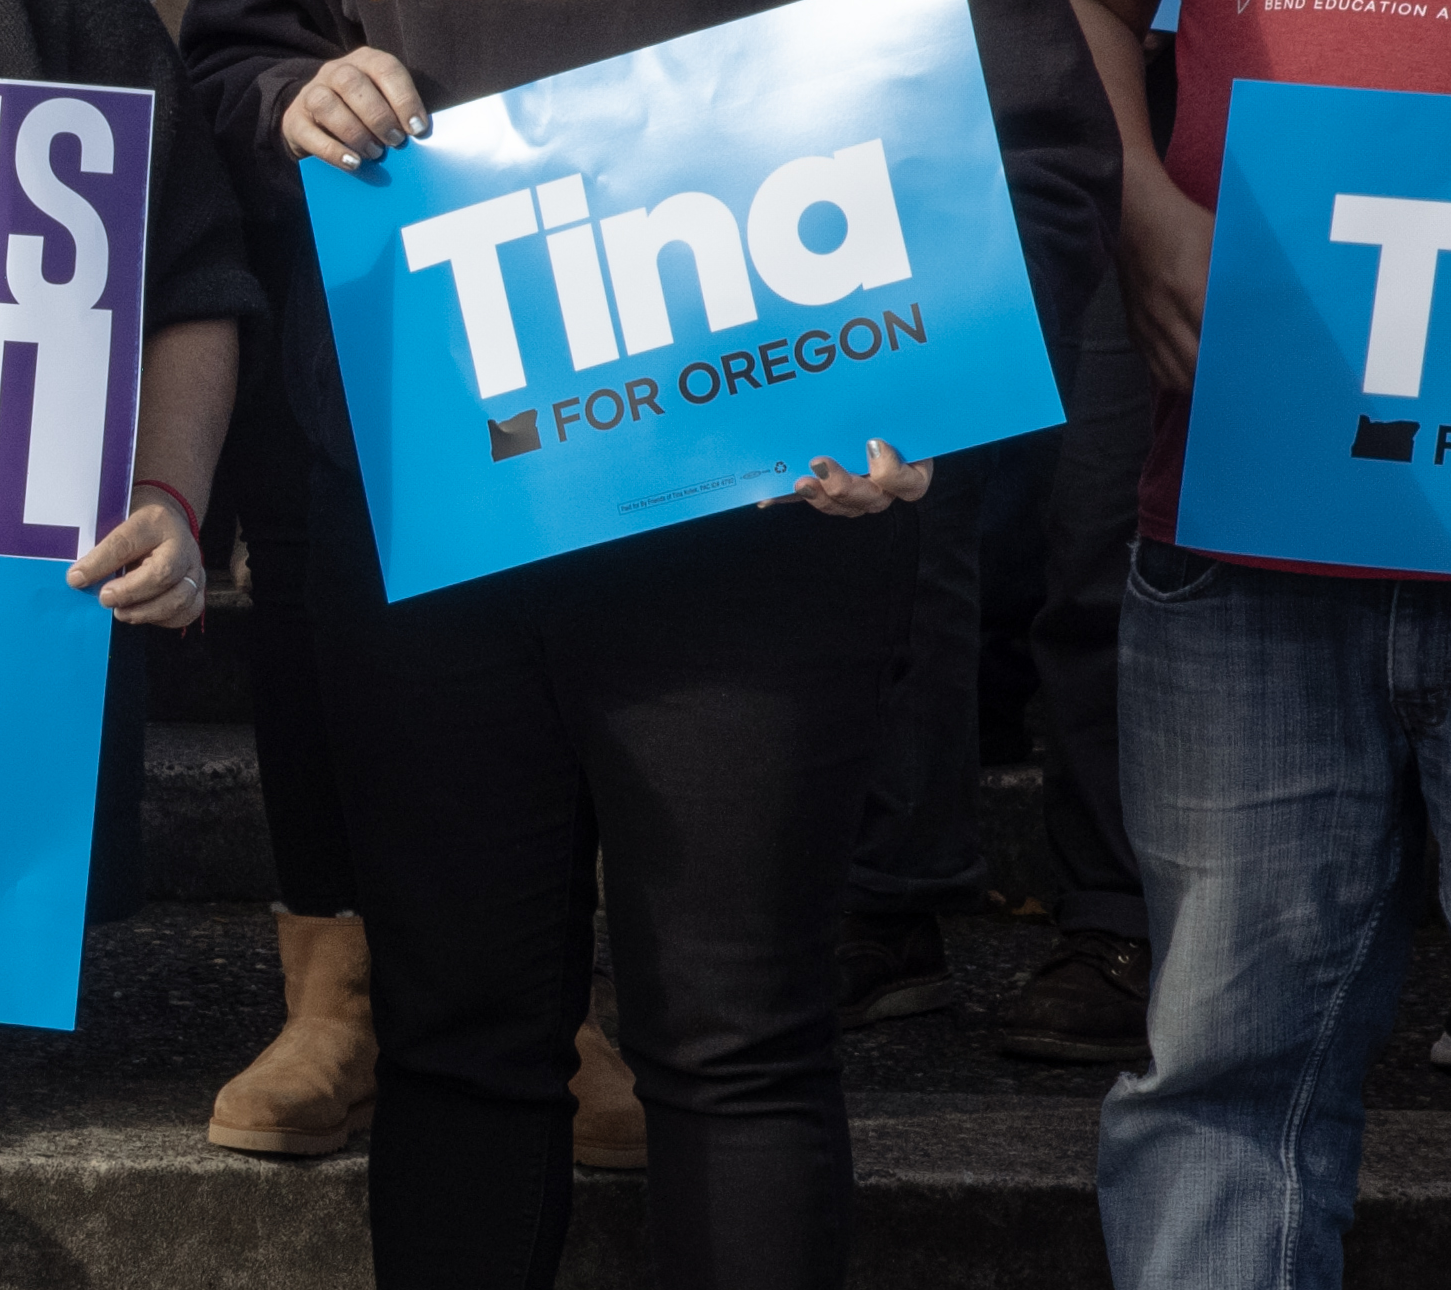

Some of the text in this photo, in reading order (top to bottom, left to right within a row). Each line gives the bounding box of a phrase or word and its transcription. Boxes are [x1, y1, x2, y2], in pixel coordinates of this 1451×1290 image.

[401, 139, 912, 399] Tina
[553, 303, 927, 442] FOR OREGON
